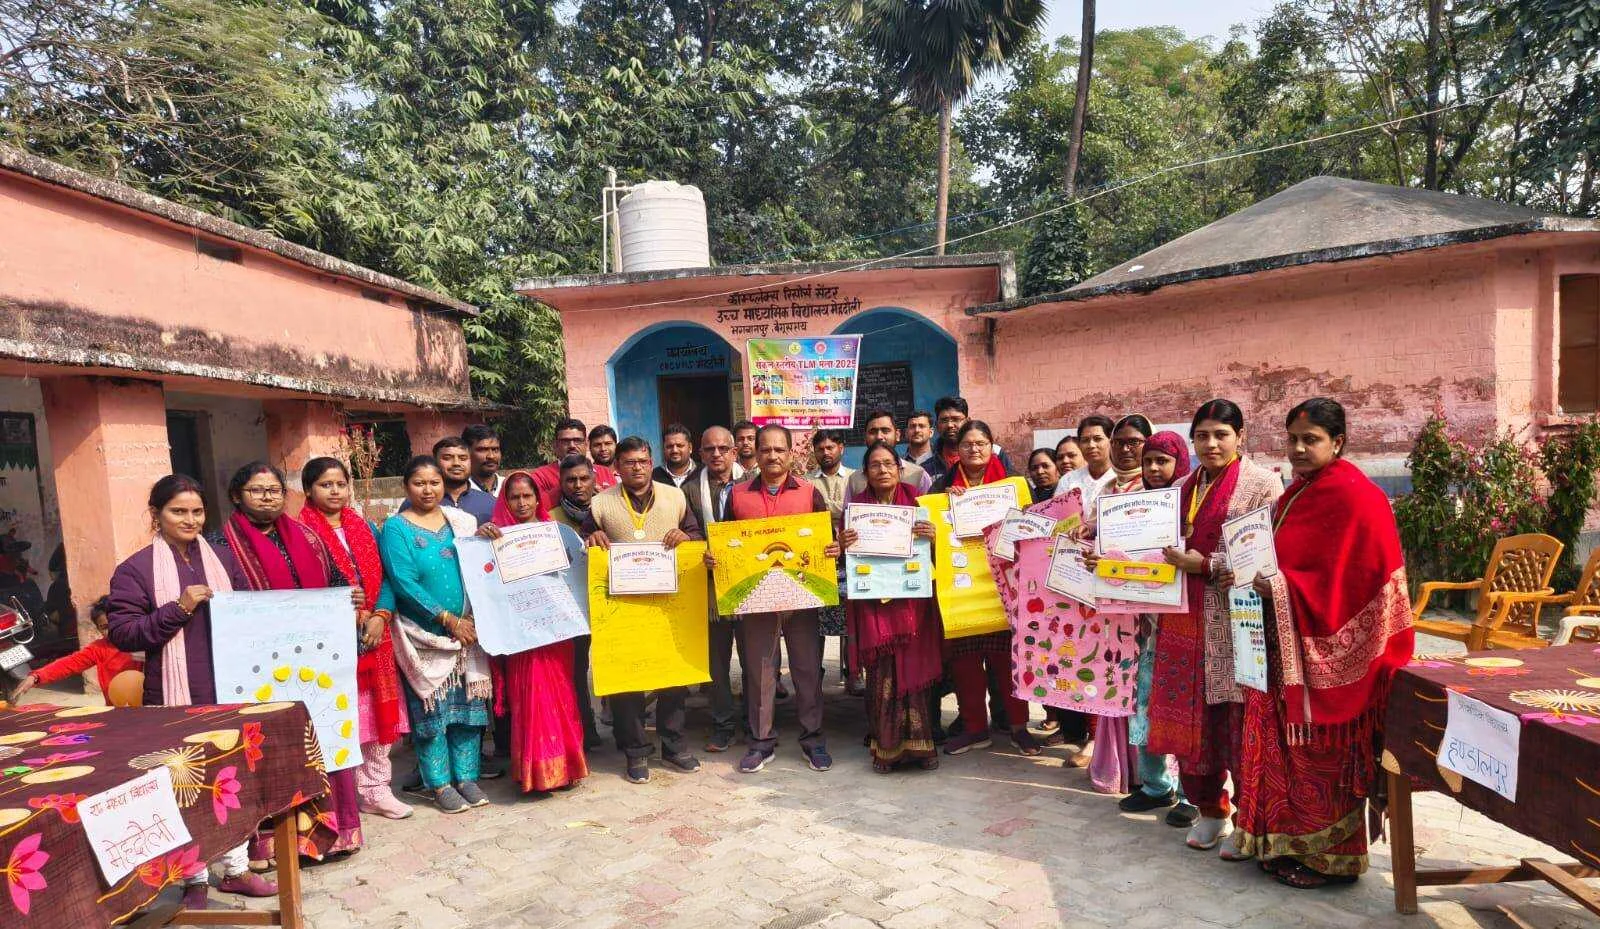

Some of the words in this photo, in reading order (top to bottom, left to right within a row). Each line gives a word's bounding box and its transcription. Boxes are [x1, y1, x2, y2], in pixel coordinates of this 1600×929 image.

[717, 309, 740, 323] उच्च
[743, 304, 789, 321] माध्यमिक
[791, 302, 829, 318] विद्यालय
[799, 360, 816, 369] TLM
[836, 359, 857, 369] 2025
